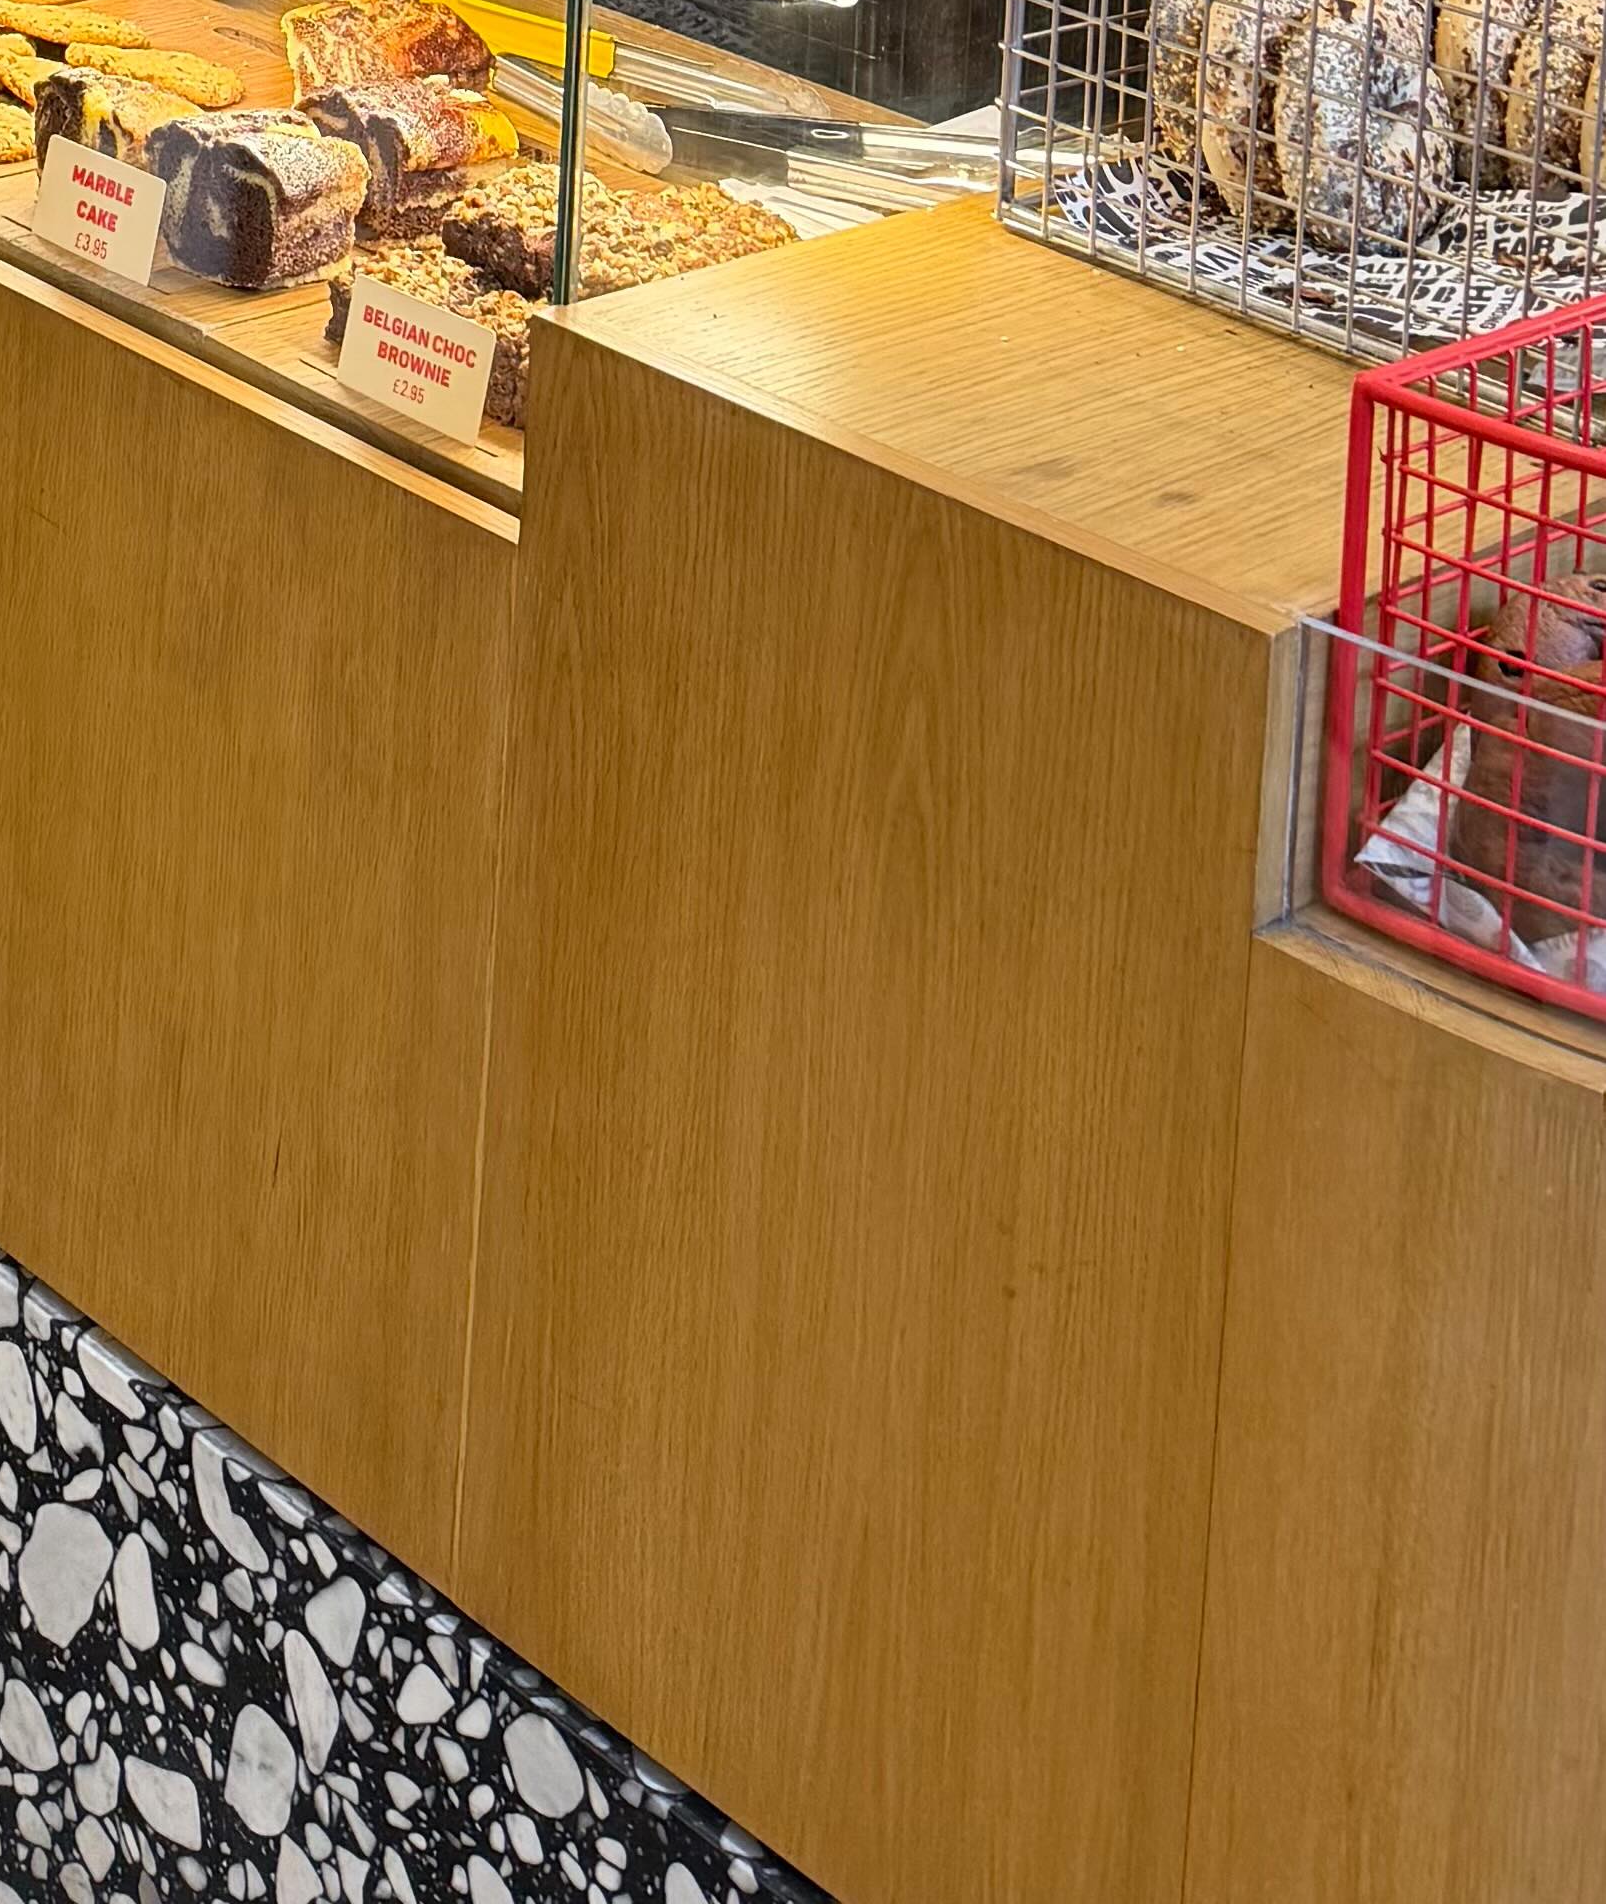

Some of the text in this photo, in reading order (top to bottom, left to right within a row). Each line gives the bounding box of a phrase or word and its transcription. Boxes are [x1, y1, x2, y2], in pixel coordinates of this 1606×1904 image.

[71, 164, 135, 207] MARBLE
[76, 199, 119, 233] CAKE
[74, 232, 108, 260] £3.95
[362, 304, 478, 369] BELGIAN CHOC
[377, 340, 453, 388] BROWNIE
[392, 378, 426, 405] £2.95
